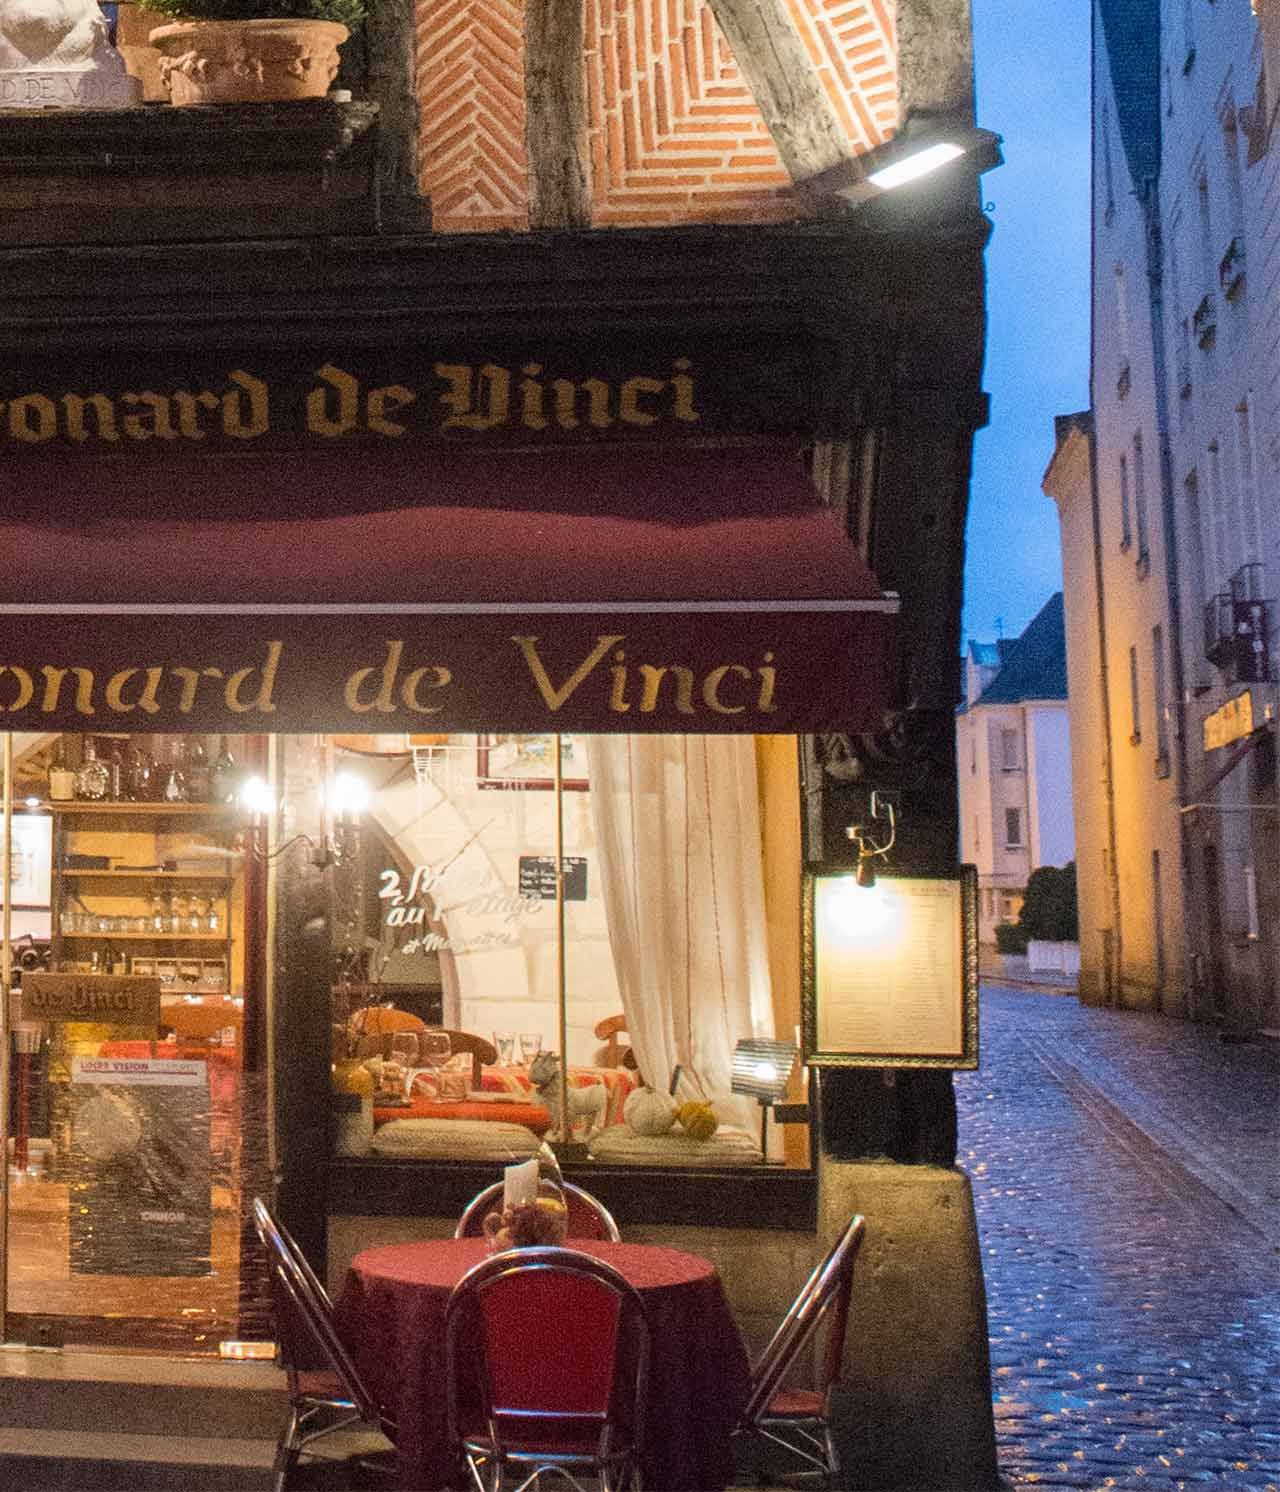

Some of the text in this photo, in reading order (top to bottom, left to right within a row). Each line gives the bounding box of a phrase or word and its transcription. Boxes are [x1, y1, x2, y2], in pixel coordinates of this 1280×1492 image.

[307, 364, 416, 437] de
[433, 357, 701, 433] Vinci
[343, 641, 452, 714] de
[511, 634, 779, 715] Vinci
[378, 869, 401, 898] 2
